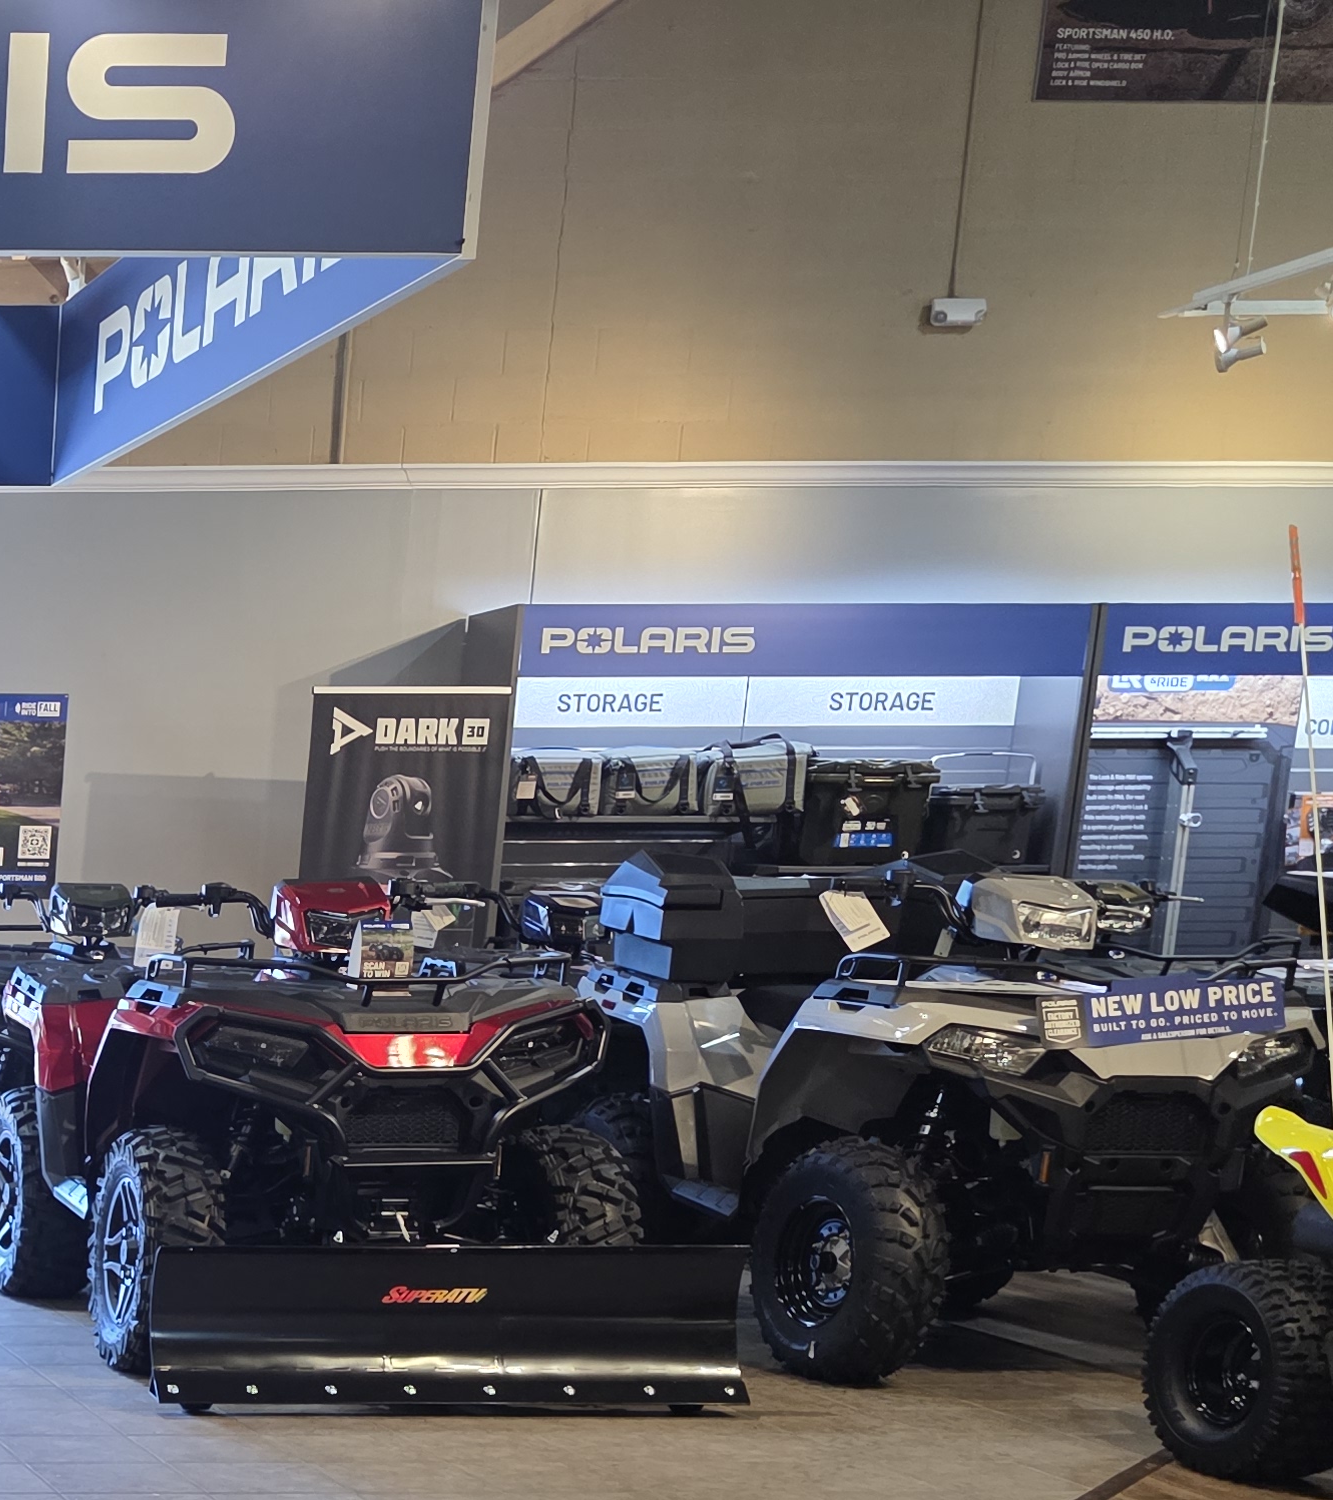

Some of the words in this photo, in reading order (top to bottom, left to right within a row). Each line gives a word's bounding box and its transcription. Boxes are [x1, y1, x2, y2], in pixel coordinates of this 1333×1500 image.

[1056, 27, 1128, 40] SPORTSMAN
[1129, 29, 1150, 40] 450
[539, 626, 756, 654] POLARIS
[38, 702, 58, 713] FALL
[556, 693, 664, 714] STORAGE
[828, 691, 936, 712] STORAGE
[375, 718, 459, 745] DARK
[466, 726, 485, 738] 30
[362, 969, 373, 978] TO
[363, 961, 386, 970] SCAN
[1090, 993, 1144, 1018] NEW
[1149, 988, 1201, 1013] LOW
[1207, 981, 1277, 1008] PRICE
[1092, 1021, 1127, 1033] BUILT
[1131, 1020, 1146, 1029] TO
[1174, 1013, 1219, 1026] PRICED
[1222, 1011, 1238, 1021] TO
[1241, 1007, 1279, 1020] MOVE.
